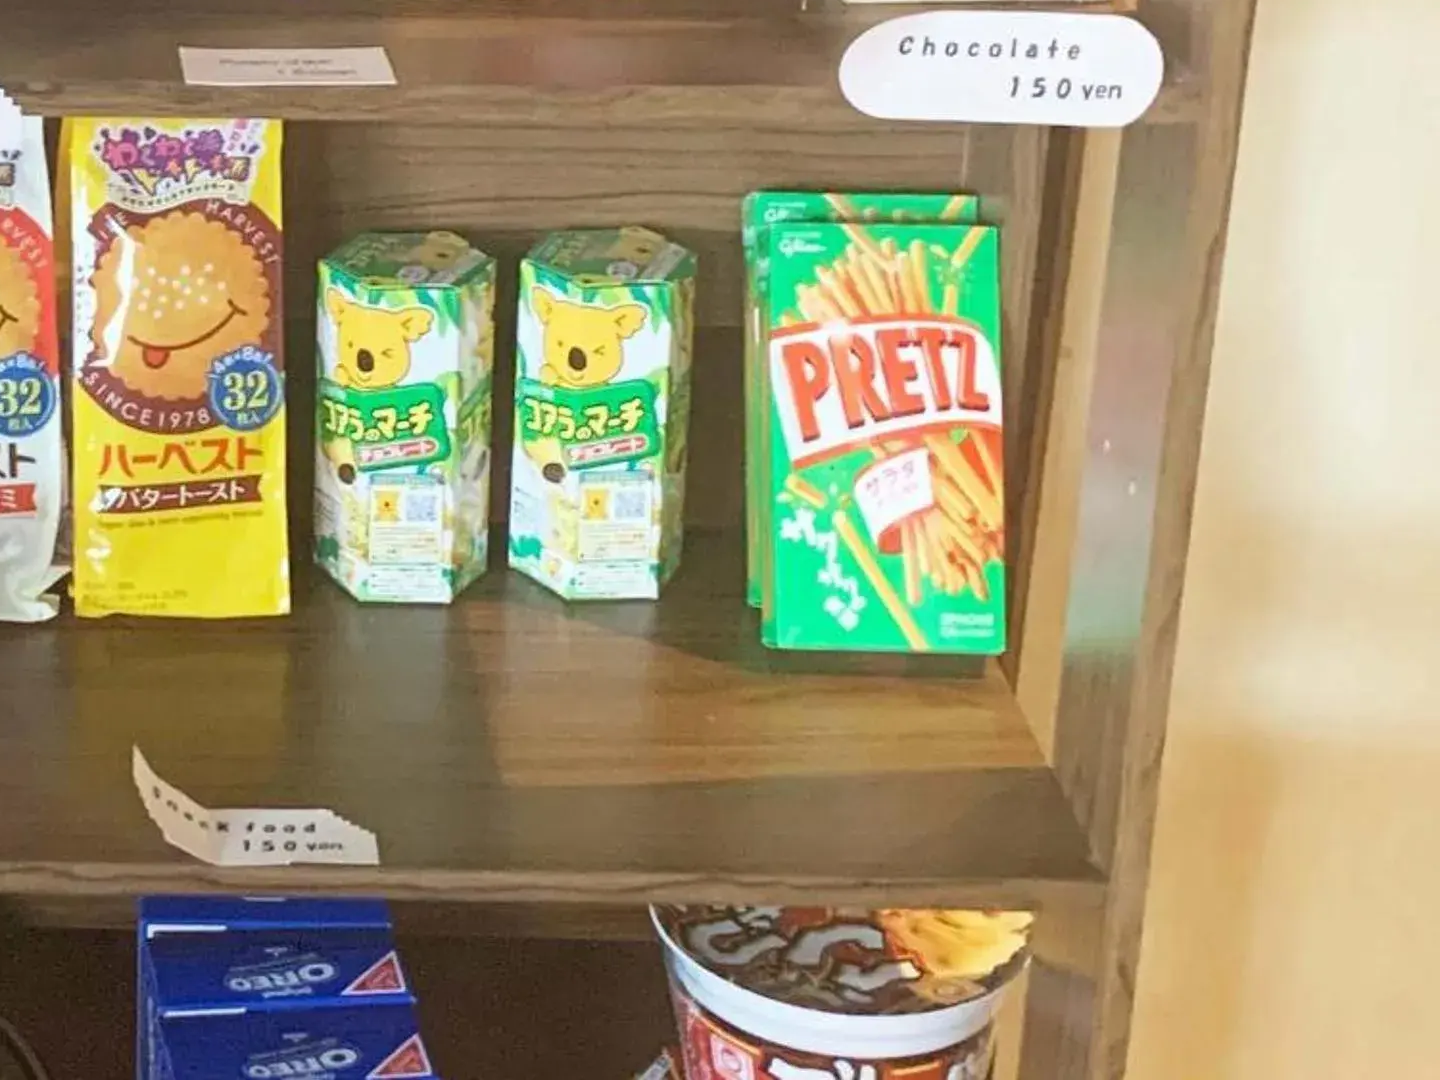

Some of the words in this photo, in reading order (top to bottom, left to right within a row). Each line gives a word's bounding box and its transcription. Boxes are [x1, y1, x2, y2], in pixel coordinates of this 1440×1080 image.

[899, 36, 1082, 60] Chocolate
[205, 203, 281, 264] HARVEST
[83, 370, 153, 426] SINCE
[159, 406, 211, 428] 1978
[223, 371, 268, 411] 32
[782, 326, 990, 443] PRETZ
[98, 440, 264, 477] ハーベスト
[228, 962, 335, 992] OREO
[247, 1047, 359, 1079] OREO
